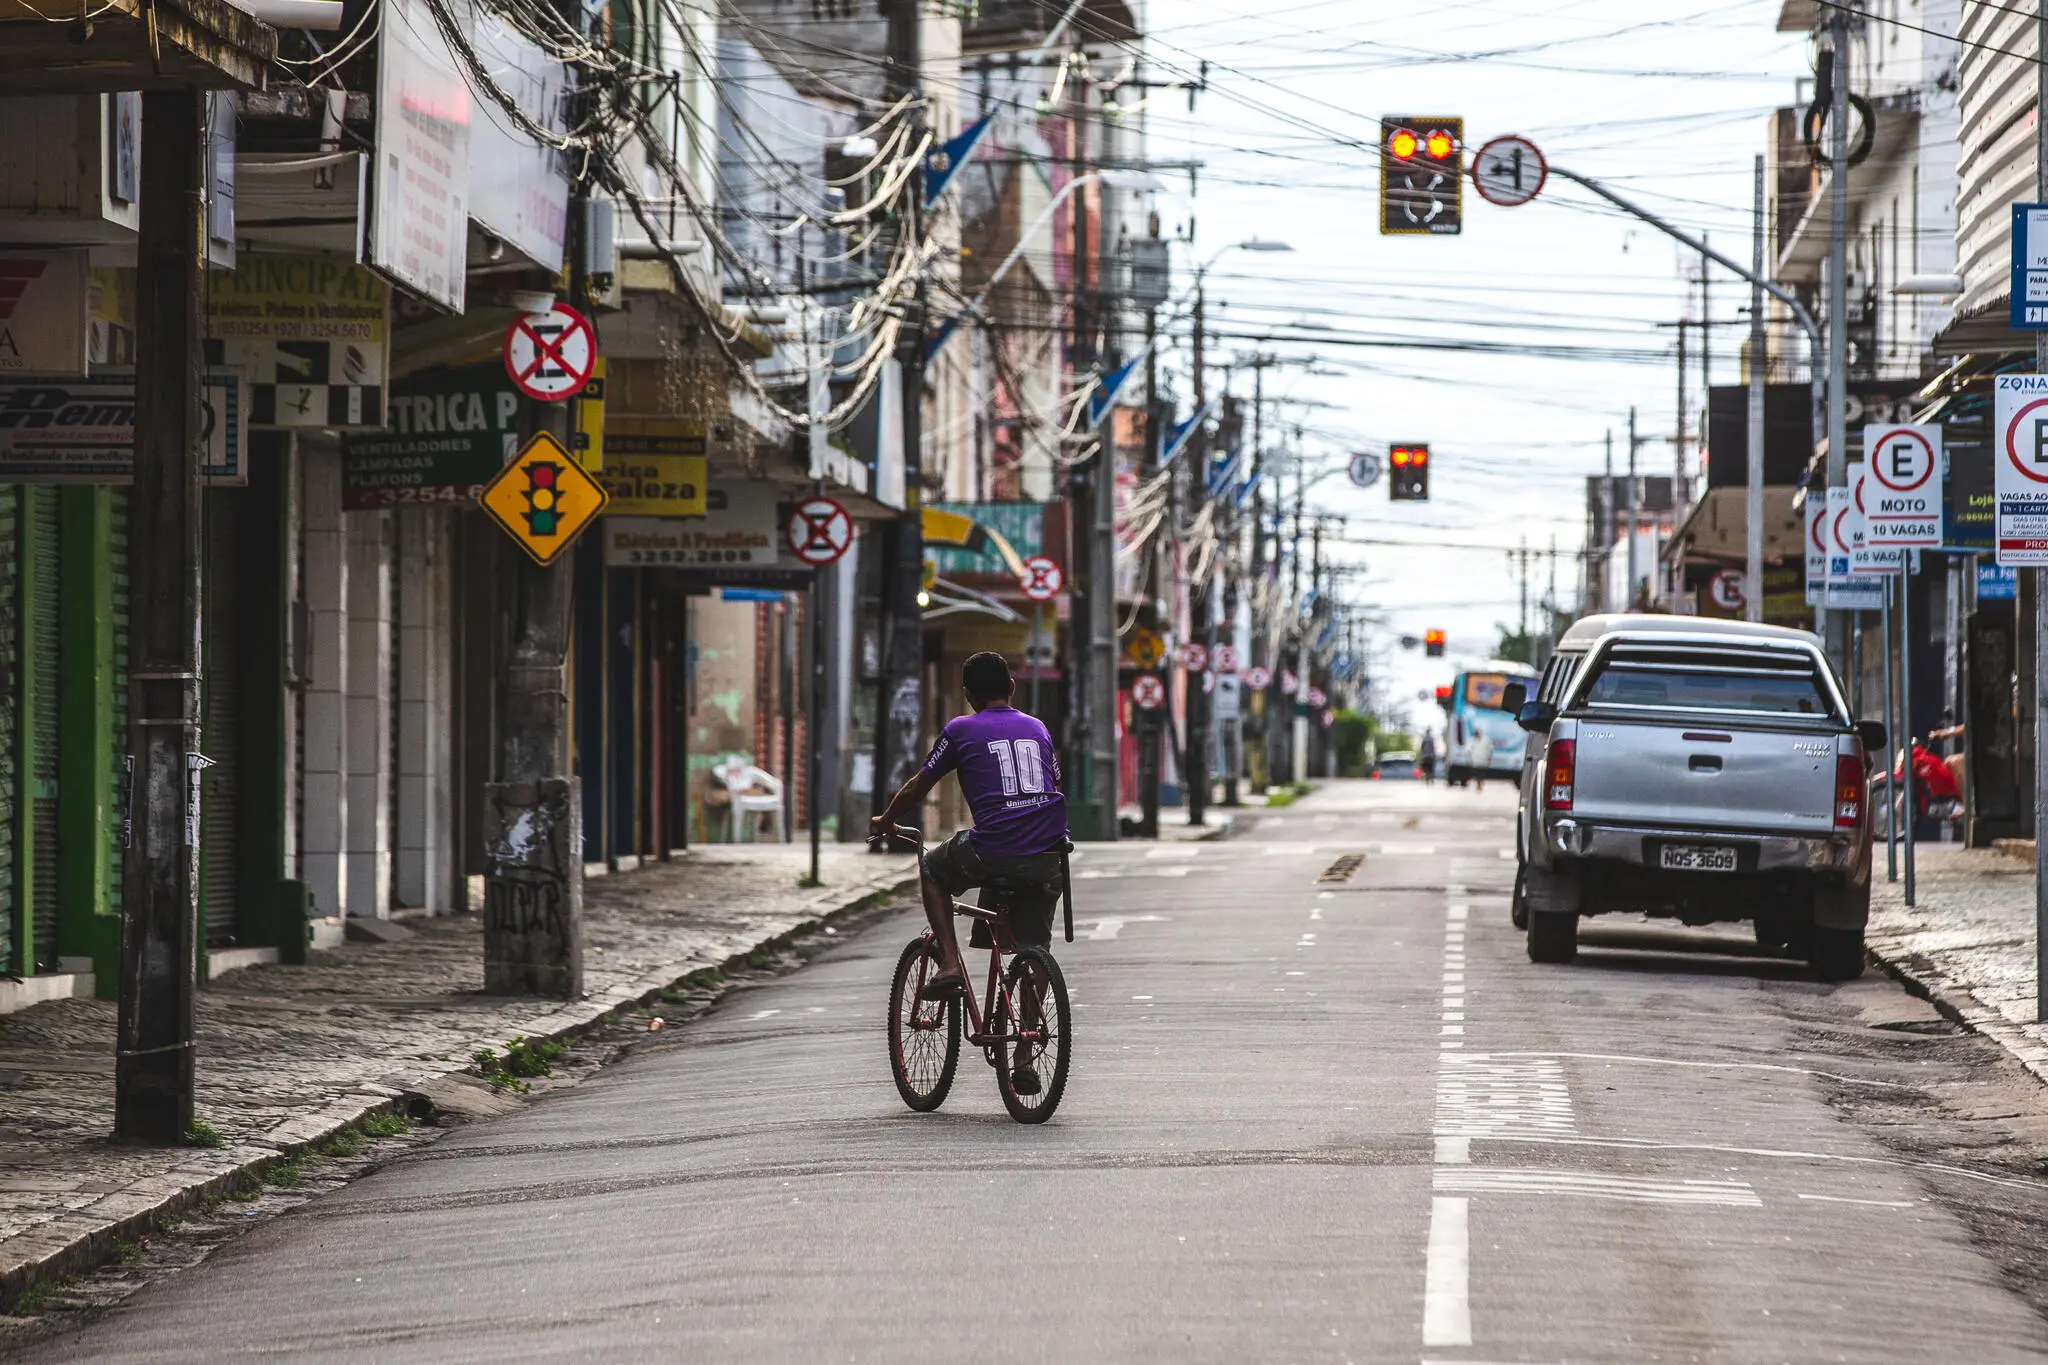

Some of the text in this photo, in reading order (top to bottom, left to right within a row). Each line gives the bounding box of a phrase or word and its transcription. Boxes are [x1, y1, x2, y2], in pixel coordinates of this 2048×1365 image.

[213, 259, 382, 301] PRINCIPAL
[347, 438, 472, 456] VENTILADORES
[1892, 443, 1914, 477] E
[349, 471, 424, 487] PLAFONS
[2000, 492, 2032, 501] VAGAS
[1881, 499, 1926, 512] MOTO
[1873, 523, 1936, 536] 10 VAGAS
[1584, 729, 1616, 739] TOYOTA
[927, 737, 949, 769] 99TAXIS
[987, 739, 1045, 796] 10
[1005, 795, 1037, 808] Unimed
